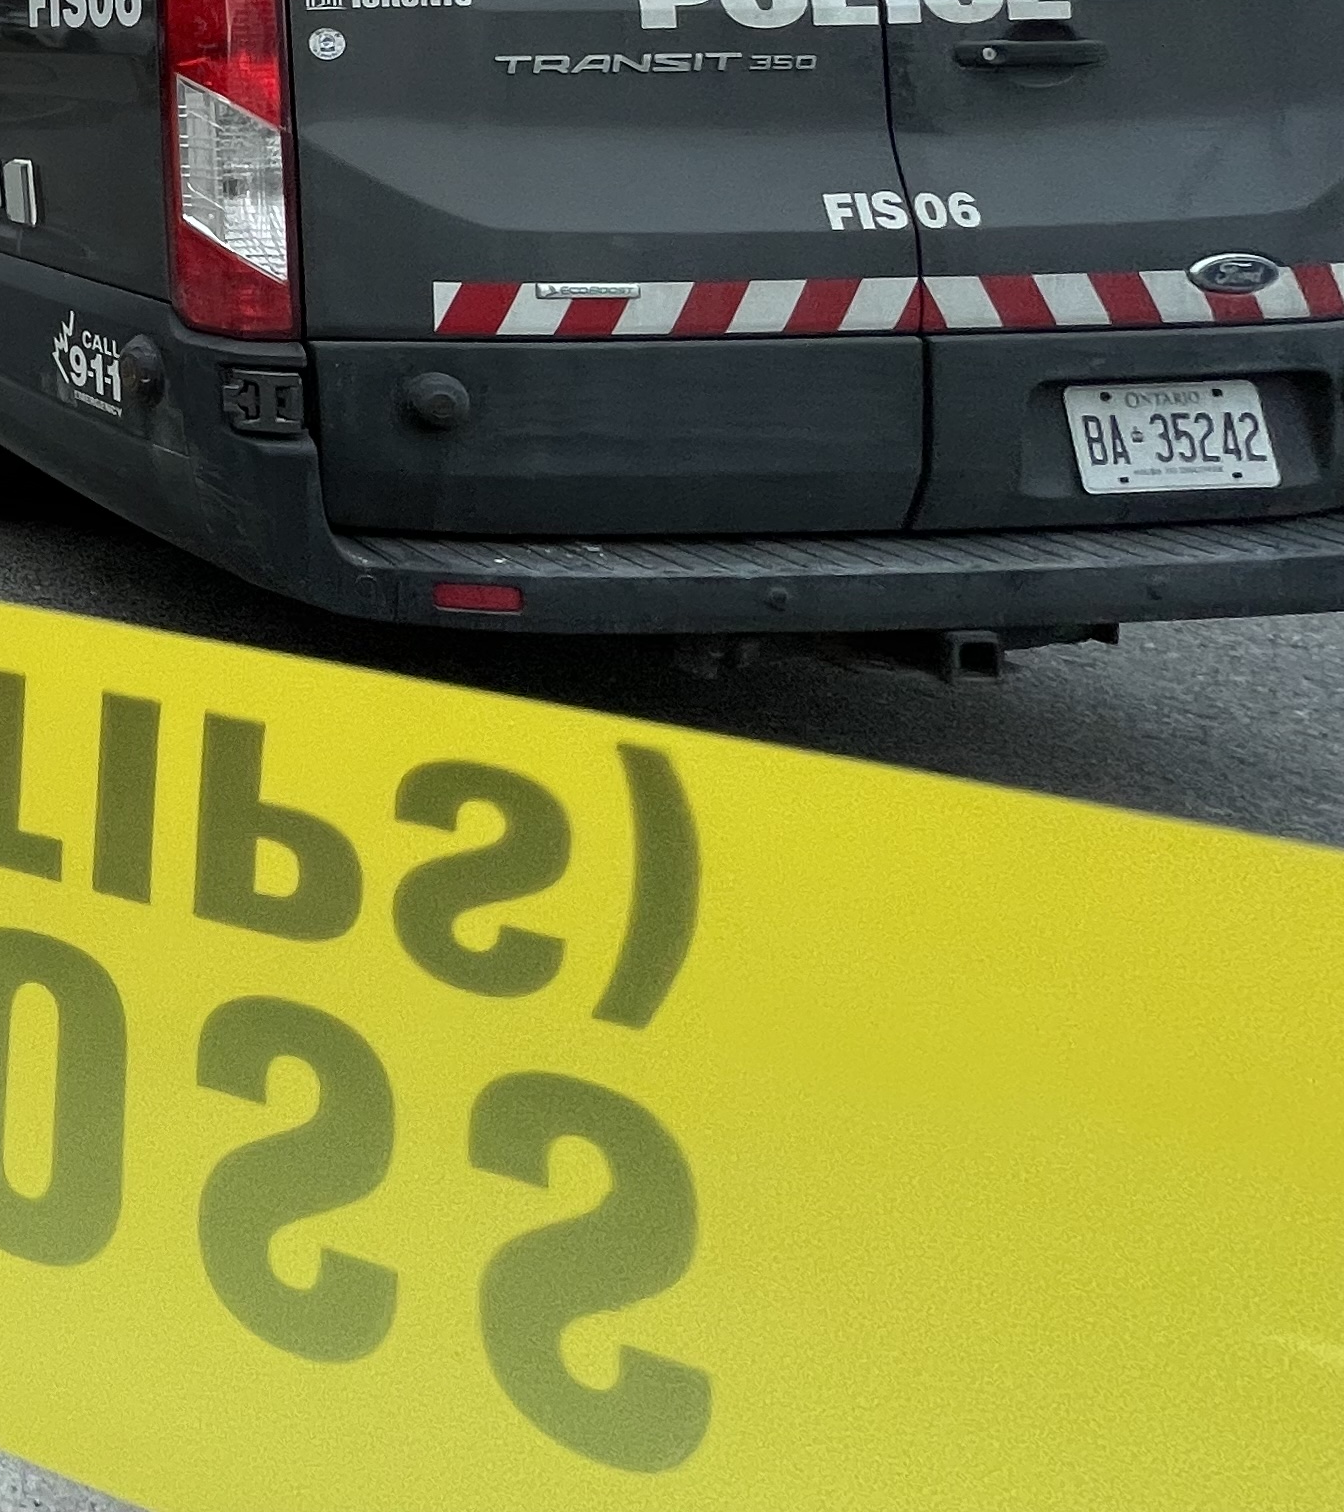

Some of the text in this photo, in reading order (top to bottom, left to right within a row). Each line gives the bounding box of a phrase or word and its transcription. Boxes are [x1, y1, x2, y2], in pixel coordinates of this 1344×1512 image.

[495, 52, 818, 75] TRANSIT 350
[81, 330, 121, 359] CALL
[69, 345, 122, 403] 9-1-1
